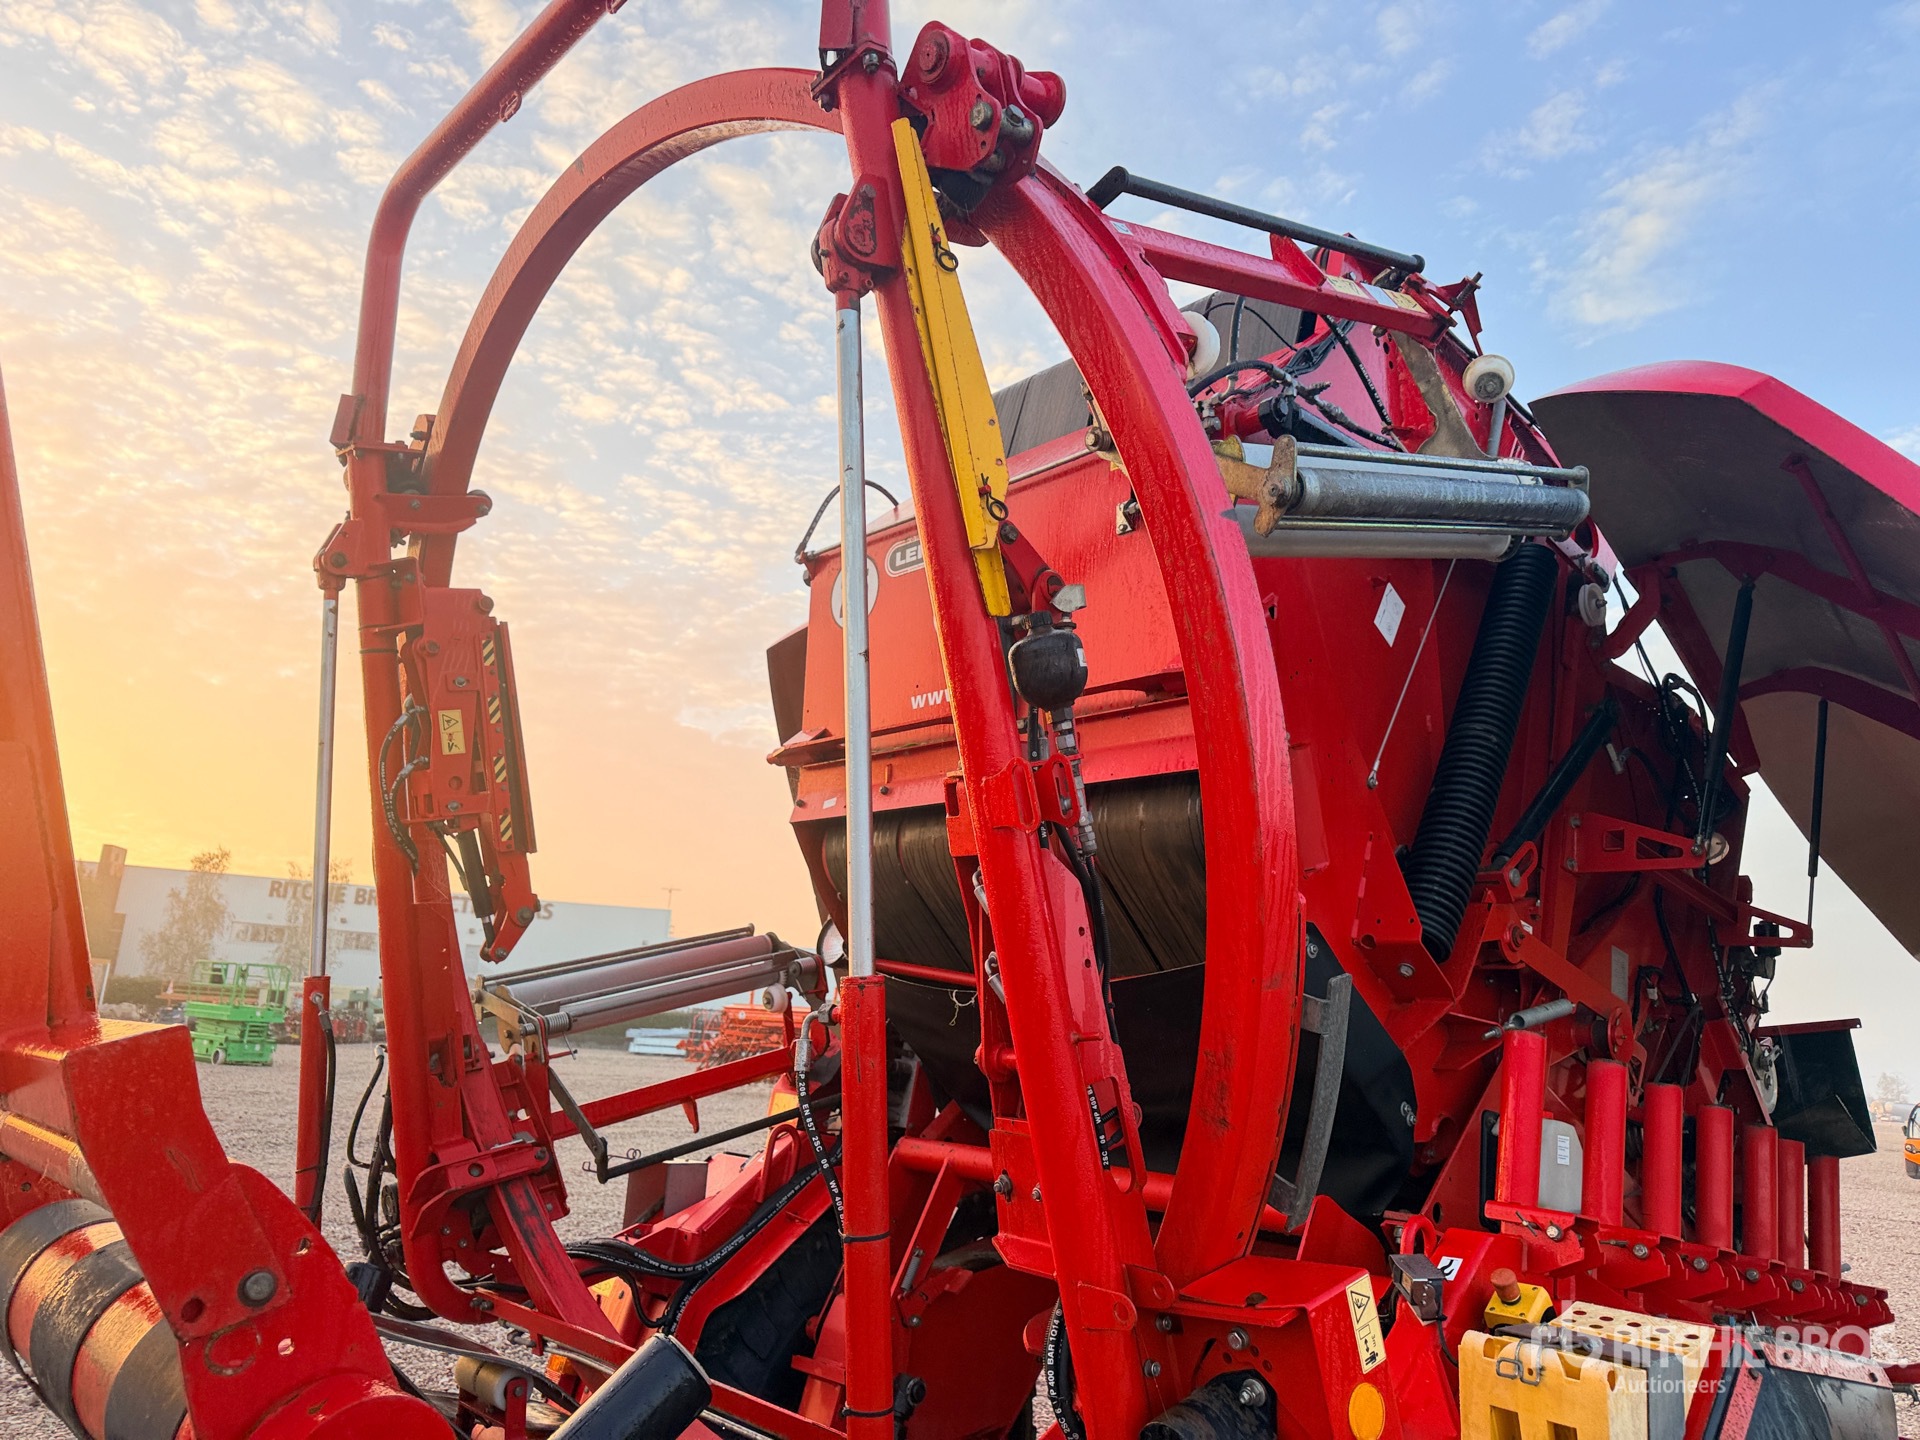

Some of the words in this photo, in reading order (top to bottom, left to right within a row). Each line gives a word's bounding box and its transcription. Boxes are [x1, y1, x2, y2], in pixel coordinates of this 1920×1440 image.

[268, 880, 347, 904] RITCIE
[799, 1082, 807, 1097] 206
[802, 1103, 811, 1117] EN
[805, 1117, 816, 1132] 857
[1093, 1112, 1101, 1125] WP
[812, 1135, 823, 1153] 2SC
[820, 1158, 830, 1170] 06
[1101, 1150, 1109, 1166] 2SC
[829, 1180, 839, 1194] WP
[835, 1196, 844, 1212] 400
[1049, 1319, 1060, 1341] 1Q14
[1047, 1344, 1056, 1365] BAR
[1058, 1417, 1071, 1434] 2SC
